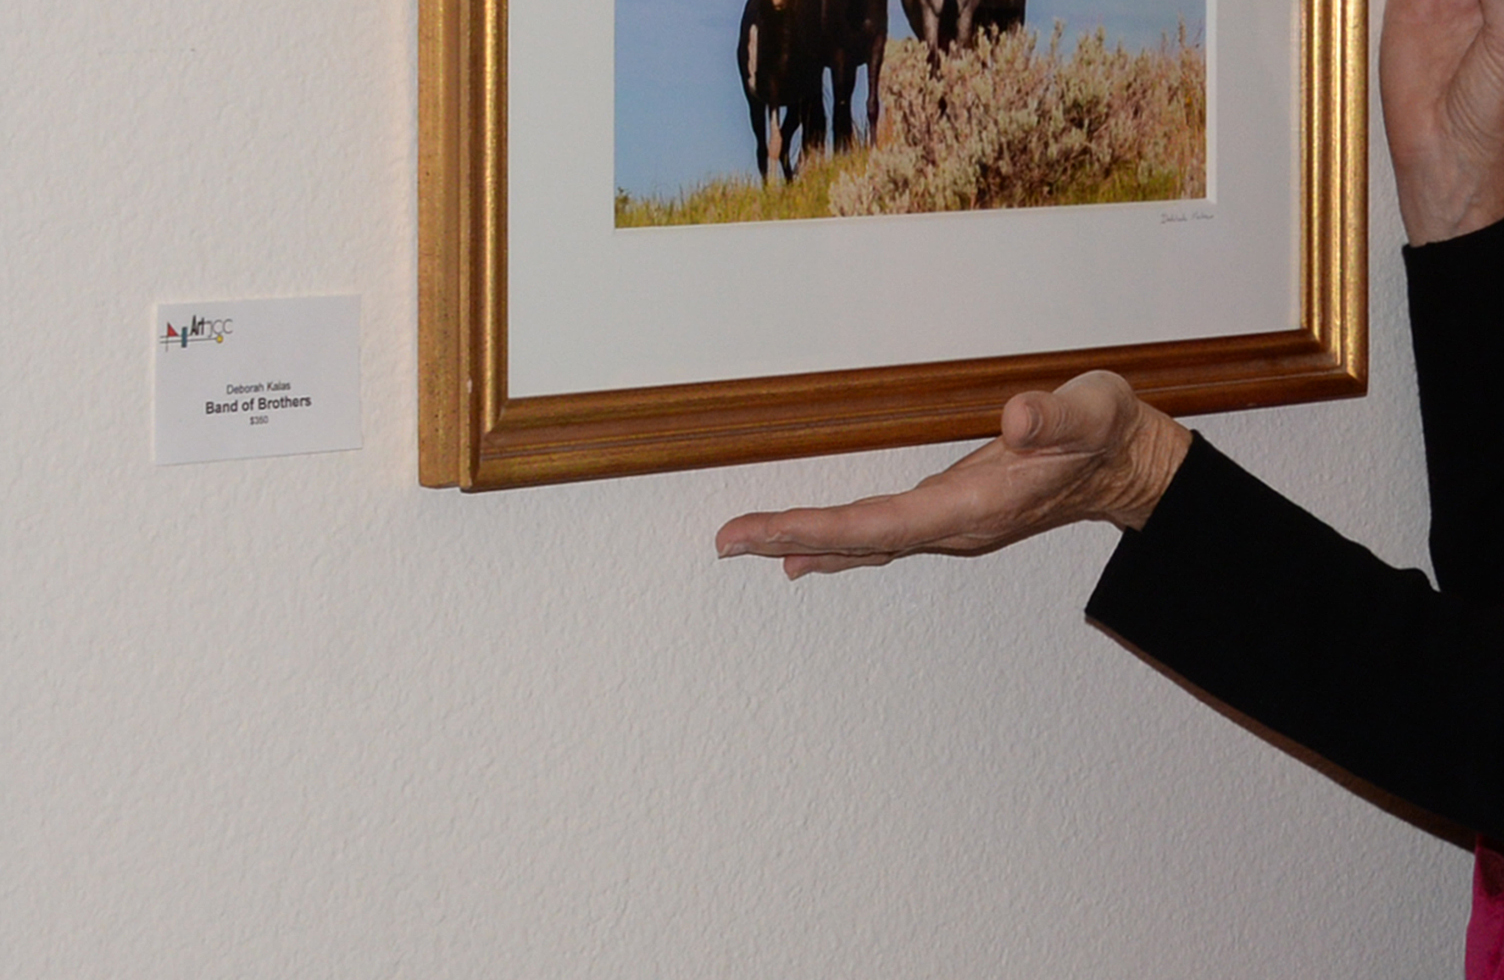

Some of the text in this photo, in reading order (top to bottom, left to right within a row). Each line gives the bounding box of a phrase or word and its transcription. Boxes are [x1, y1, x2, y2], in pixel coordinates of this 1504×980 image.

[226, 381, 291, 395] Deborah Kalas
[205, 396, 312, 414] Band of Brothers
